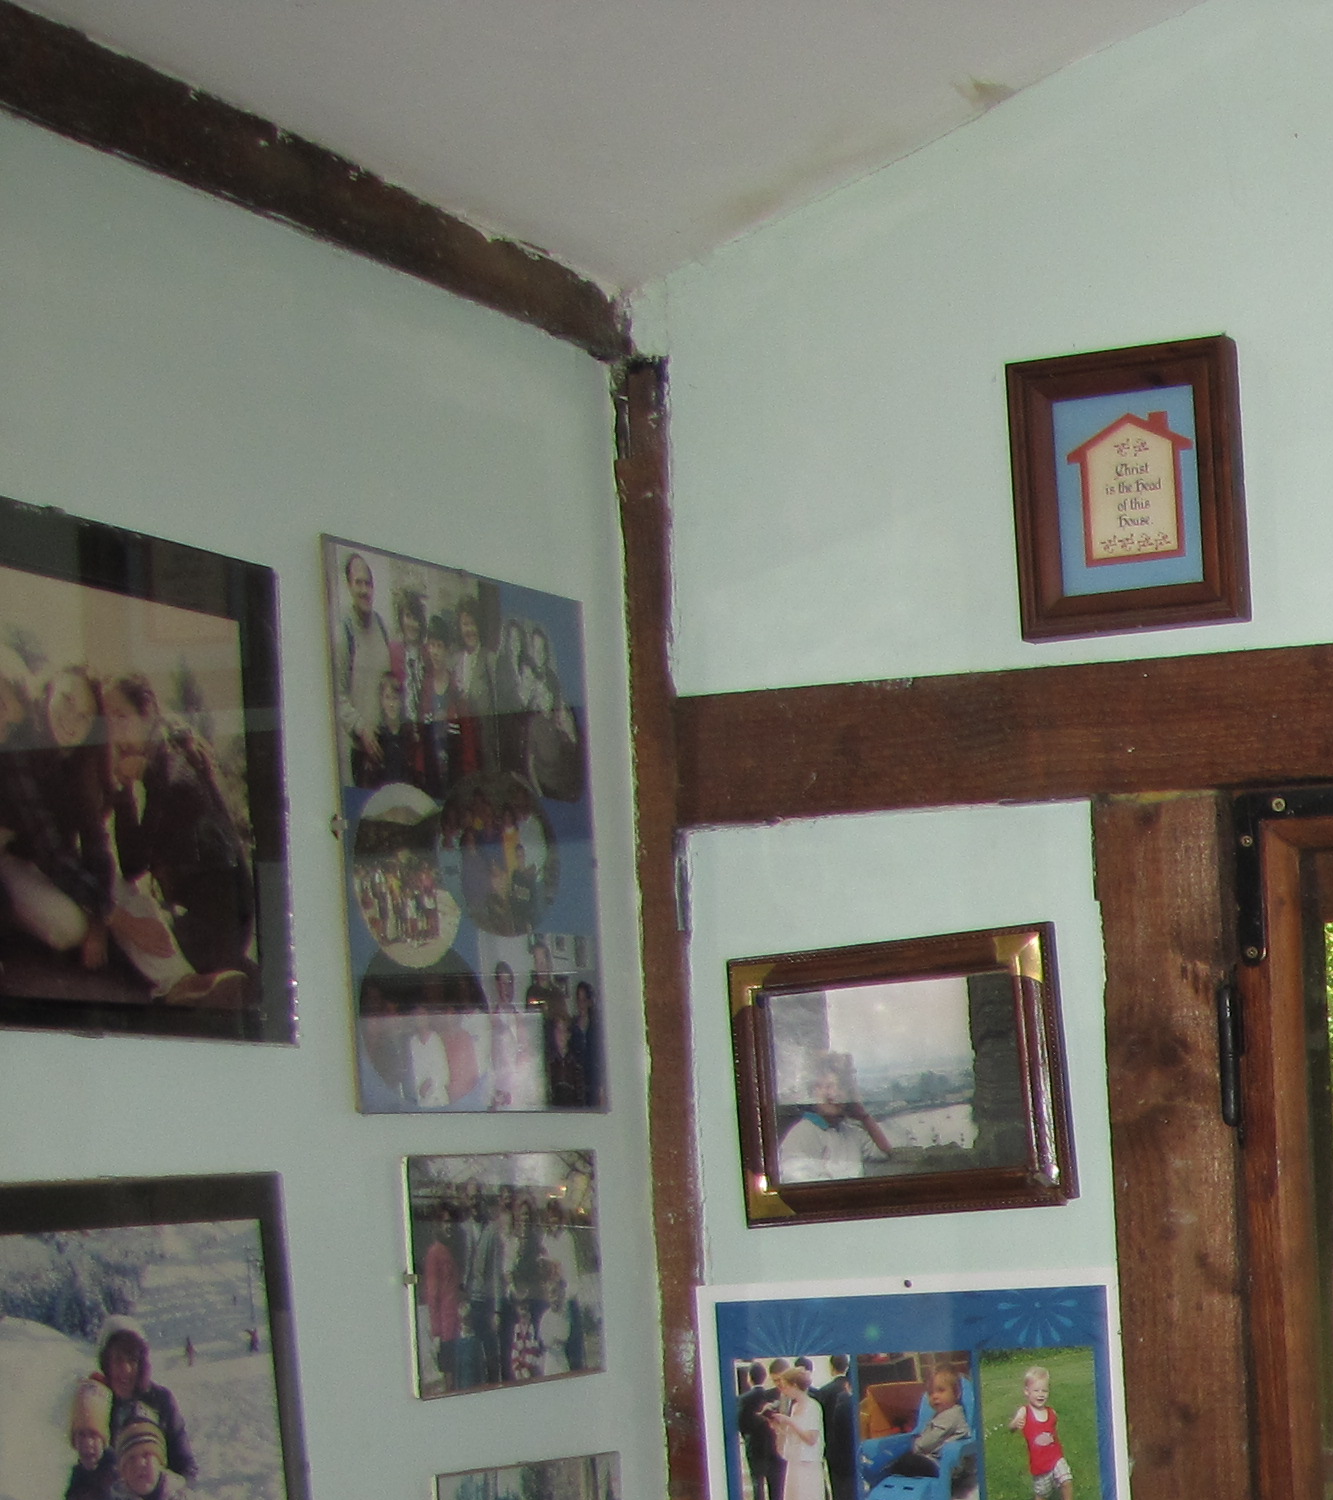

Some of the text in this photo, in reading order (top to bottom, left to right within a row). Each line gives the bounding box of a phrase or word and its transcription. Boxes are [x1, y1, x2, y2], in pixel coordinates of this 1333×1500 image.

[1114, 462, 1149, 478] Christ
[1105, 484, 1115, 495] is
[1118, 481, 1132, 494] the
[1117, 497, 1151, 511] of this
